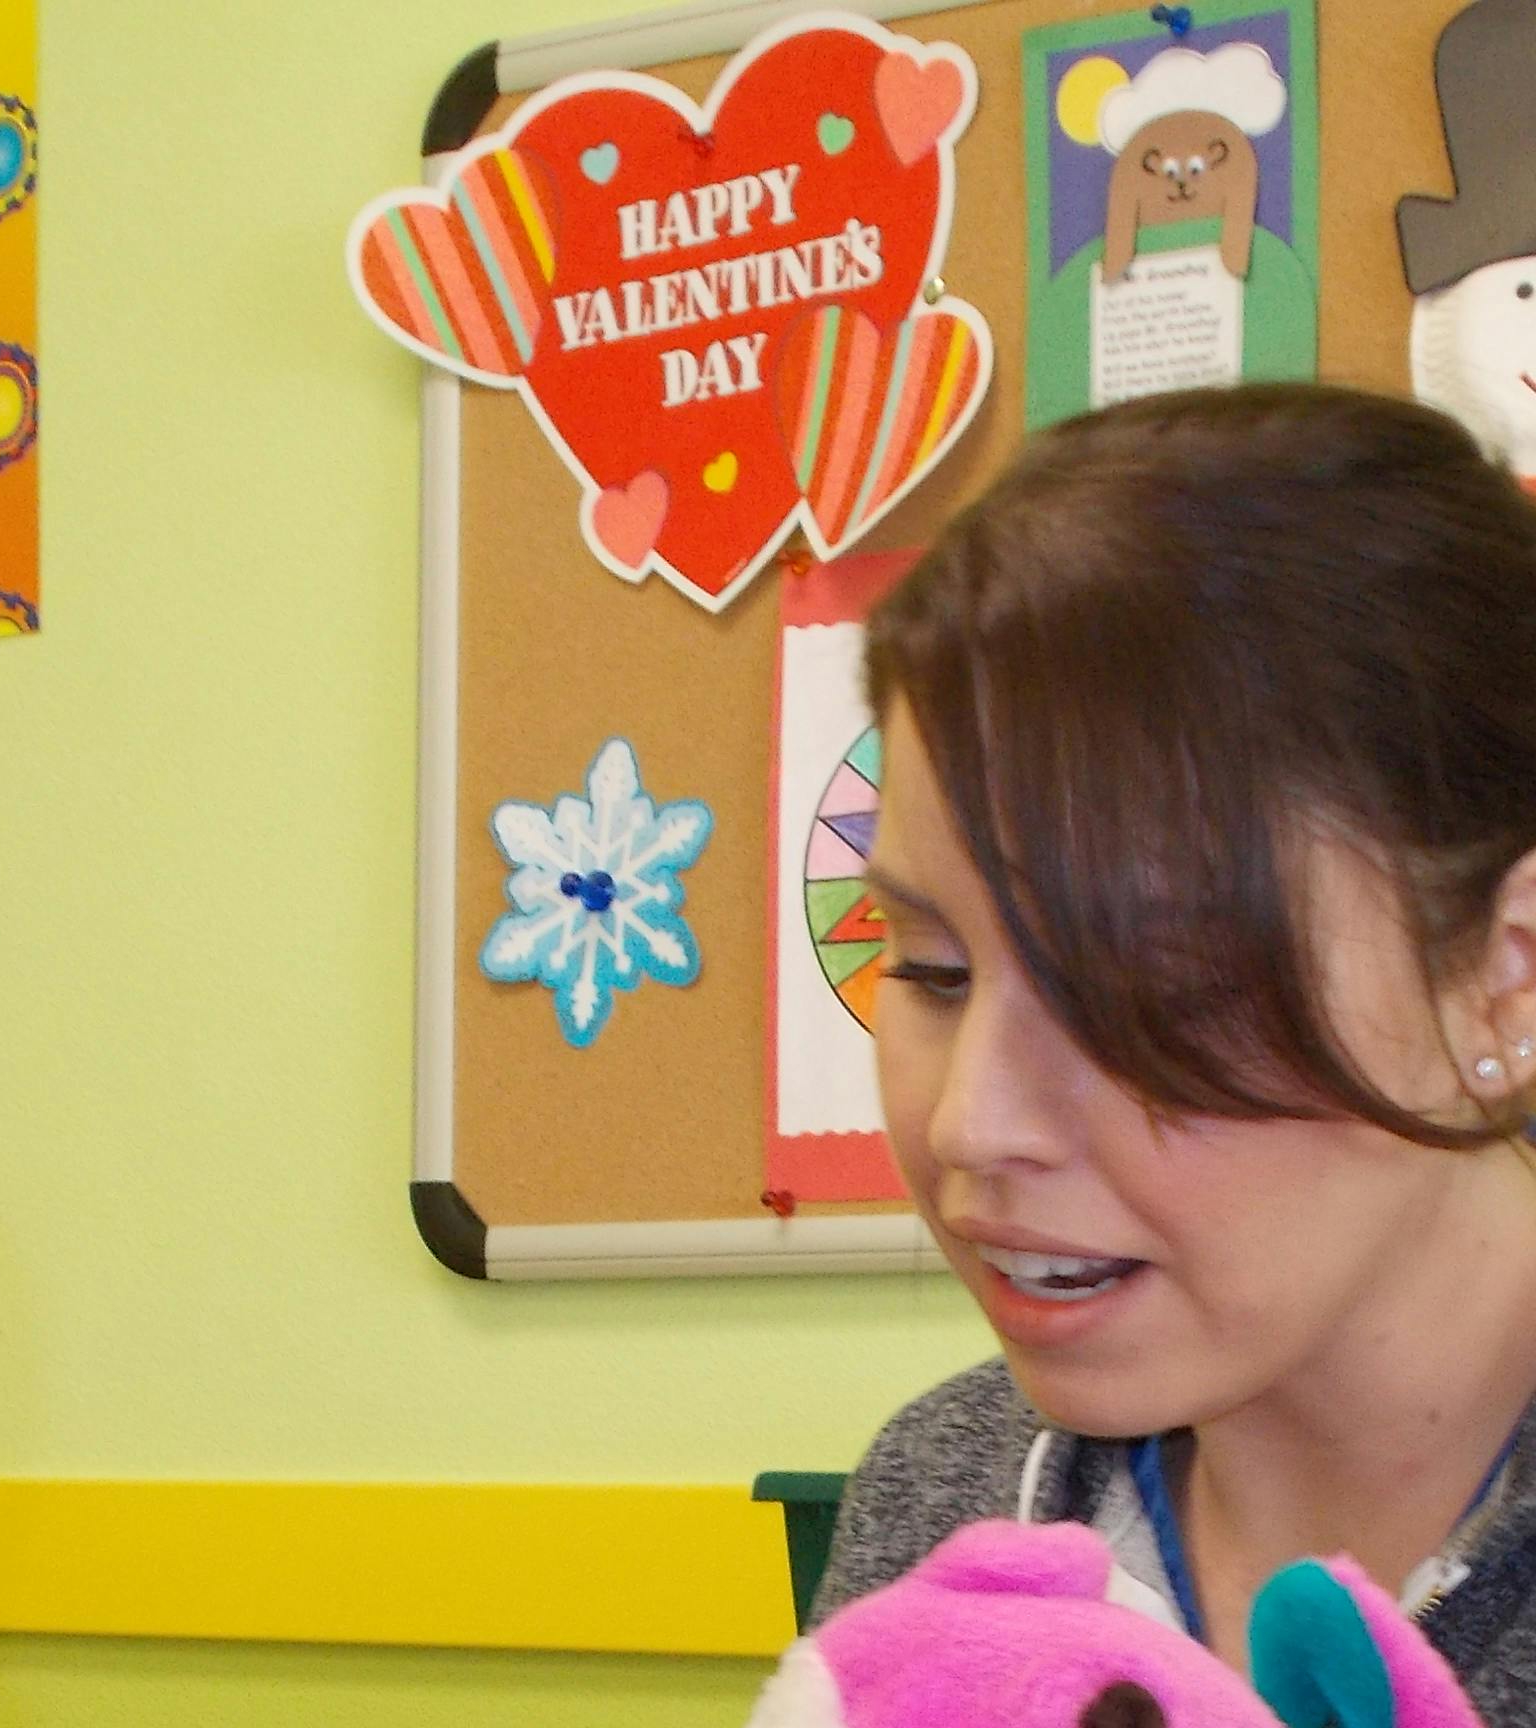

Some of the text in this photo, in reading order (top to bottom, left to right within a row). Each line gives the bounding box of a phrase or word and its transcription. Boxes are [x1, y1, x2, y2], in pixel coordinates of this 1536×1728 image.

[617, 164, 800, 260] HAPPY
[554, 217, 884, 352] VALENTINE'S
[660, 332, 768, 407] DAY
